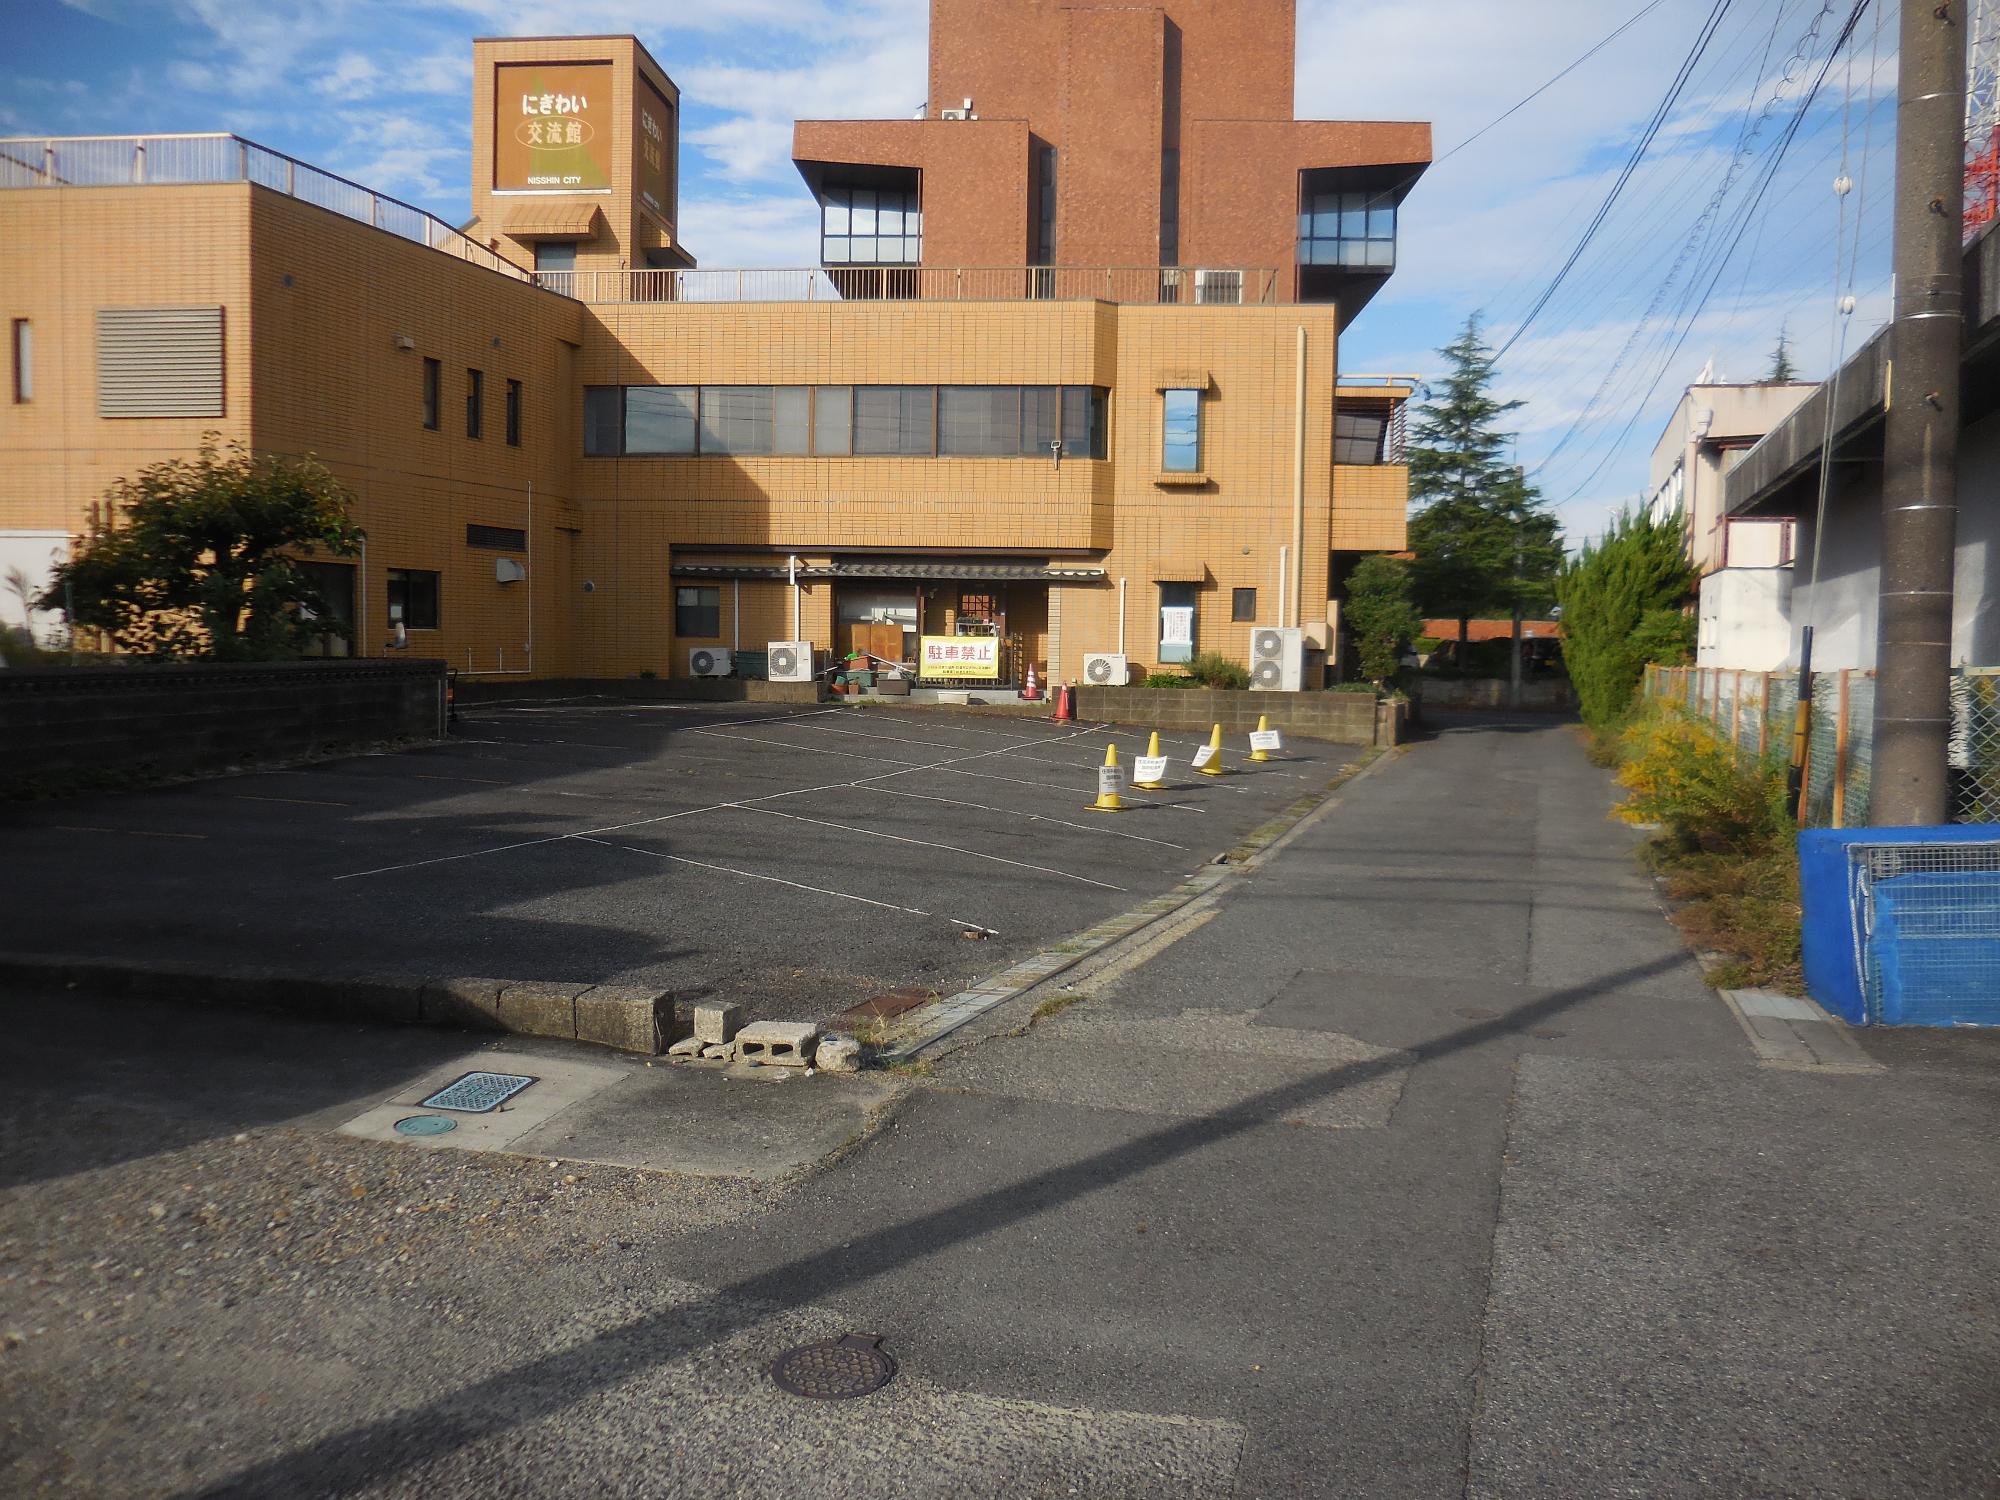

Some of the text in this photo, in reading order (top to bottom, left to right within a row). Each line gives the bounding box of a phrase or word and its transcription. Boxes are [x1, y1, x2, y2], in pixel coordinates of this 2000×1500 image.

[522, 94, 588, 115] にぎわい
[527, 121, 582, 144] 交流館
[527, 176, 582, 185] NISSHIN CITY
[928, 645, 992, 660] 駐車禁止
